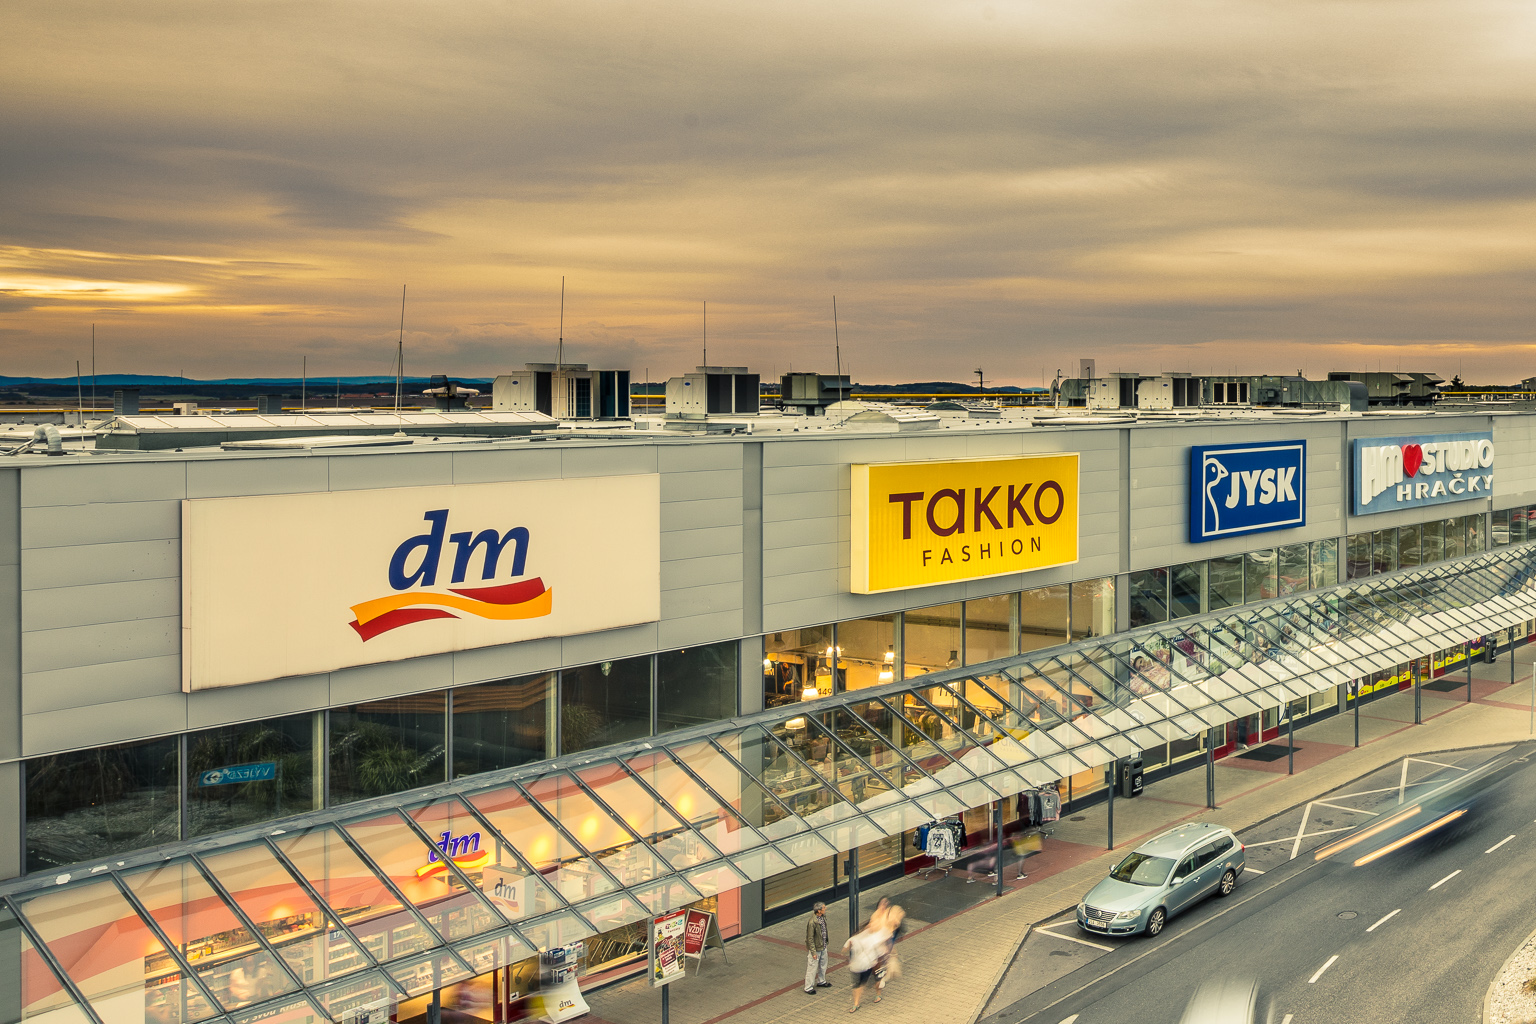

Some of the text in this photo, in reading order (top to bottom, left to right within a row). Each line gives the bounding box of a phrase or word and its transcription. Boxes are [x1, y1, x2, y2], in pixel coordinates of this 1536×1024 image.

[1419, 438, 1495, 476] STUDIO
[1225, 466, 1297, 509] JYSK
[1396, 472, 1494, 502] HRAČKY
[888, 479, 1065, 540] TAKKO
[388, 508, 530, 591] dm
[922, 536, 1042, 567] FASHION
[428, 830, 481, 864] dm
[494, 877, 517, 900] dm
[558, 999, 573, 1009] dm
